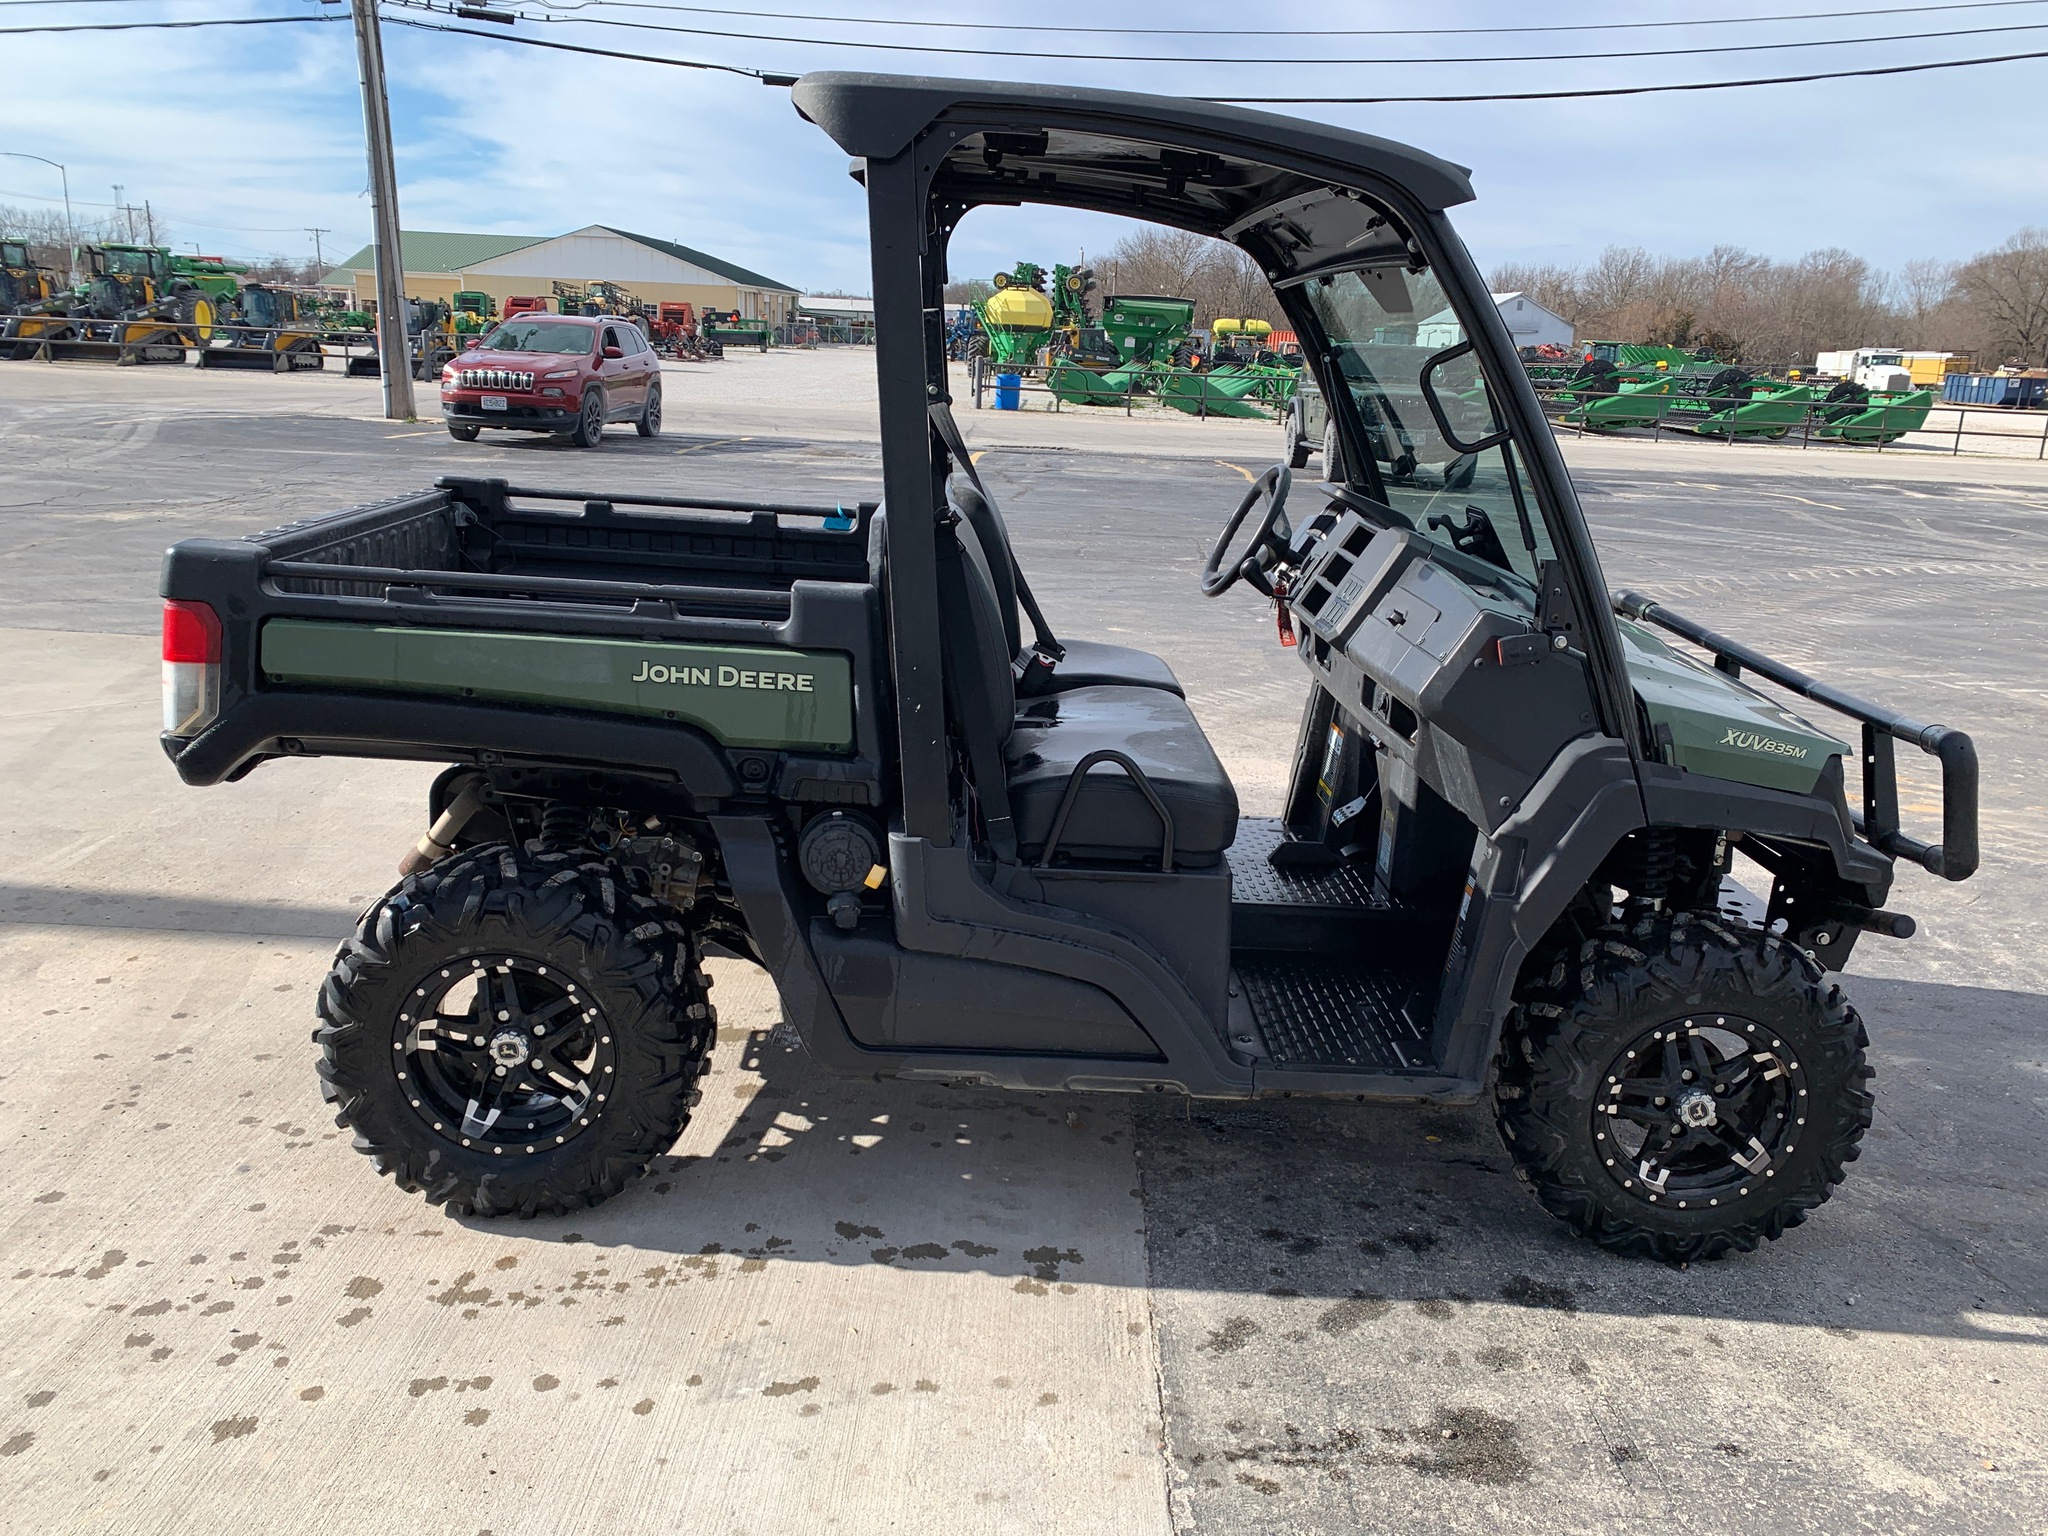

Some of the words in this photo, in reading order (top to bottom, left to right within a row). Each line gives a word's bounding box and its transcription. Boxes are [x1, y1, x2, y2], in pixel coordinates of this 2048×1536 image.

[632, 660, 711, 686] JOHN
[717, 665, 815, 693] DEERE
[1719, 729, 1808, 759] XUV835M
